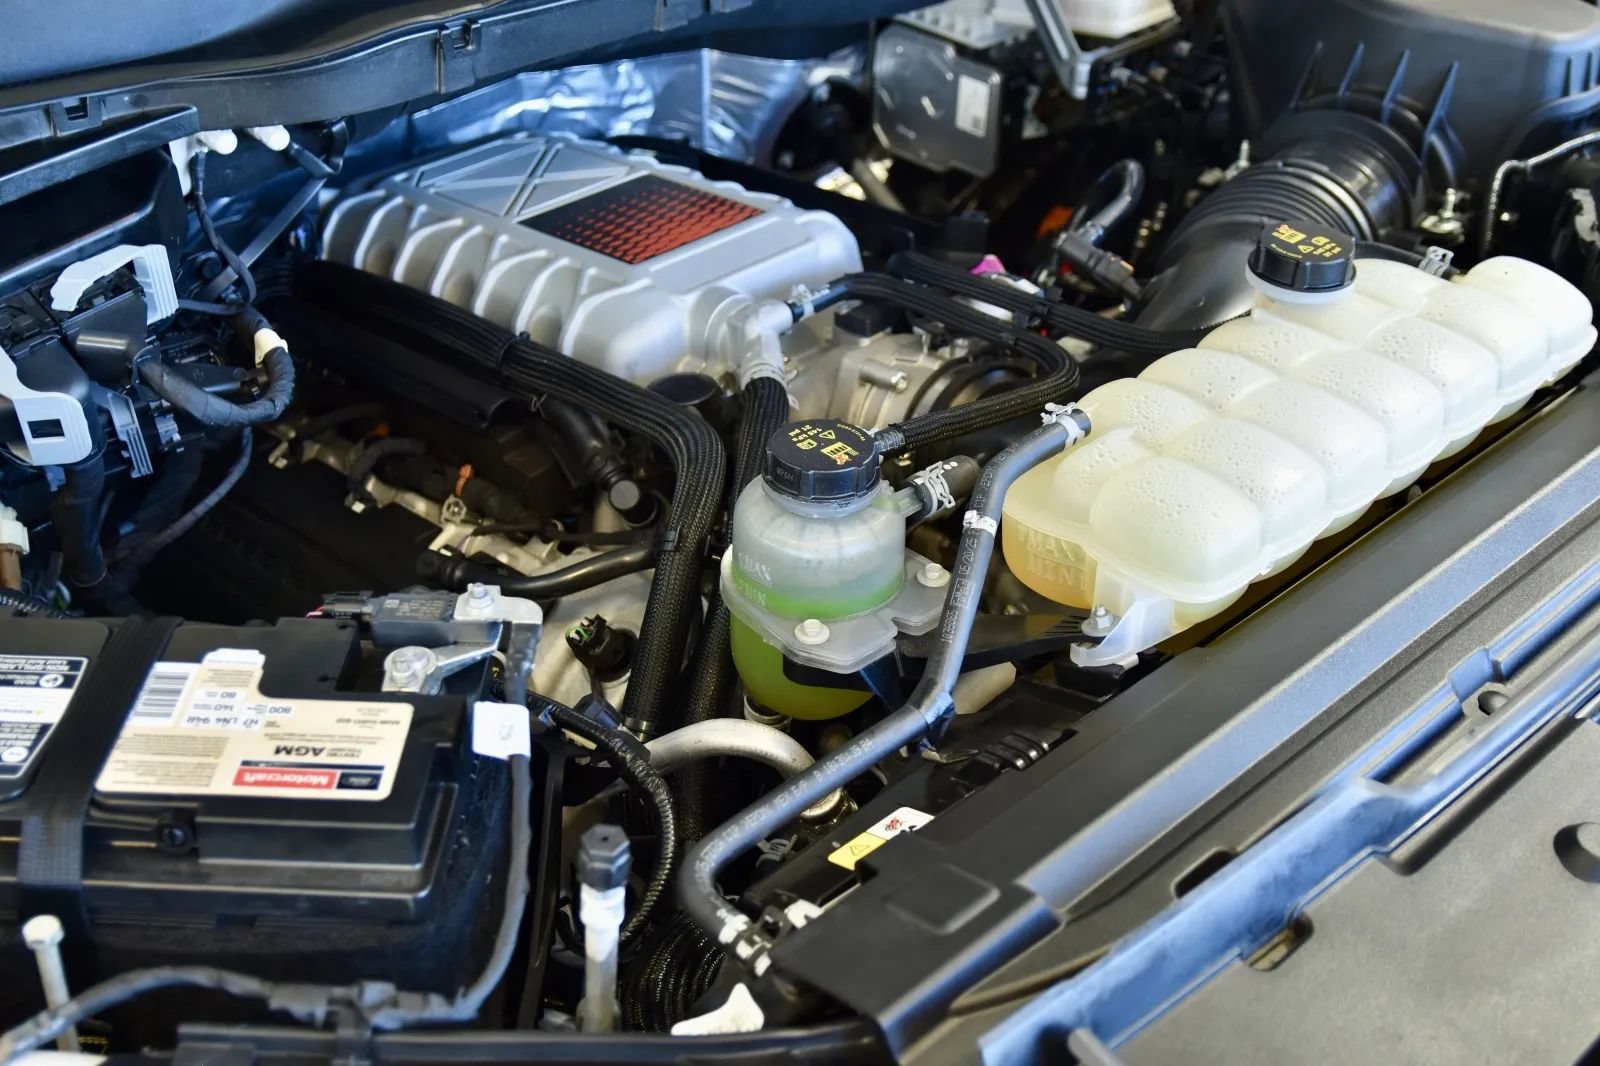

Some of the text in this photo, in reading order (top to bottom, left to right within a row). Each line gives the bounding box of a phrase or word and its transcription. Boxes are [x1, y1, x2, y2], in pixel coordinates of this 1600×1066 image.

[269, 706, 293, 714] 800
[274, 745, 326, 756] AGM
[243, 772, 329, 785] Motorcraft
